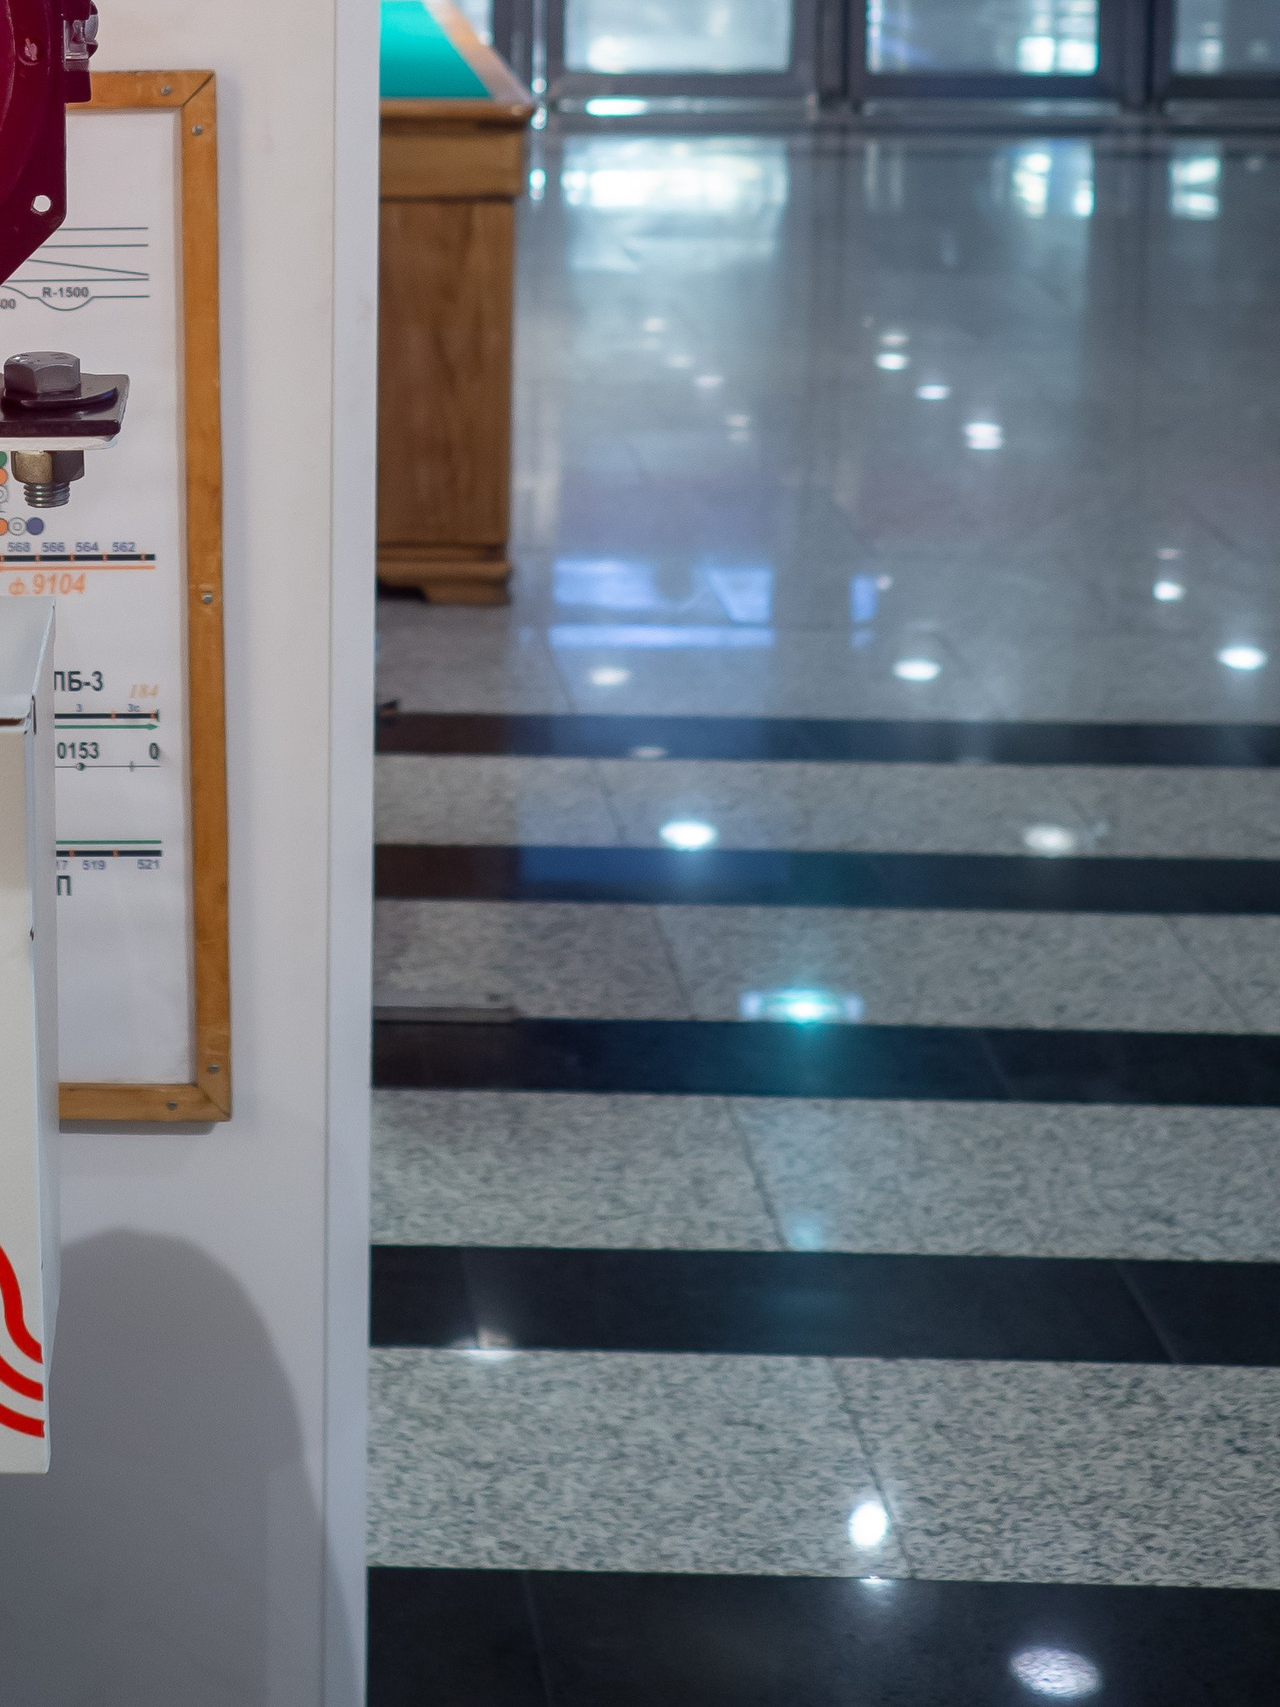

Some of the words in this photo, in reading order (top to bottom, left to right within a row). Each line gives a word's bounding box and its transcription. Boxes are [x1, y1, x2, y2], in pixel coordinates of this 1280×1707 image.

[42, 286, 90, 298] R-1500
[7, 542, 31, 553] 568
[75, 541, 99, 552] 564
[111, 541, 136, 553] 562
[56, 741, 100, 760] 0153
[82, 859, 107, 871] 519
[136, 858, 160, 870] 521
